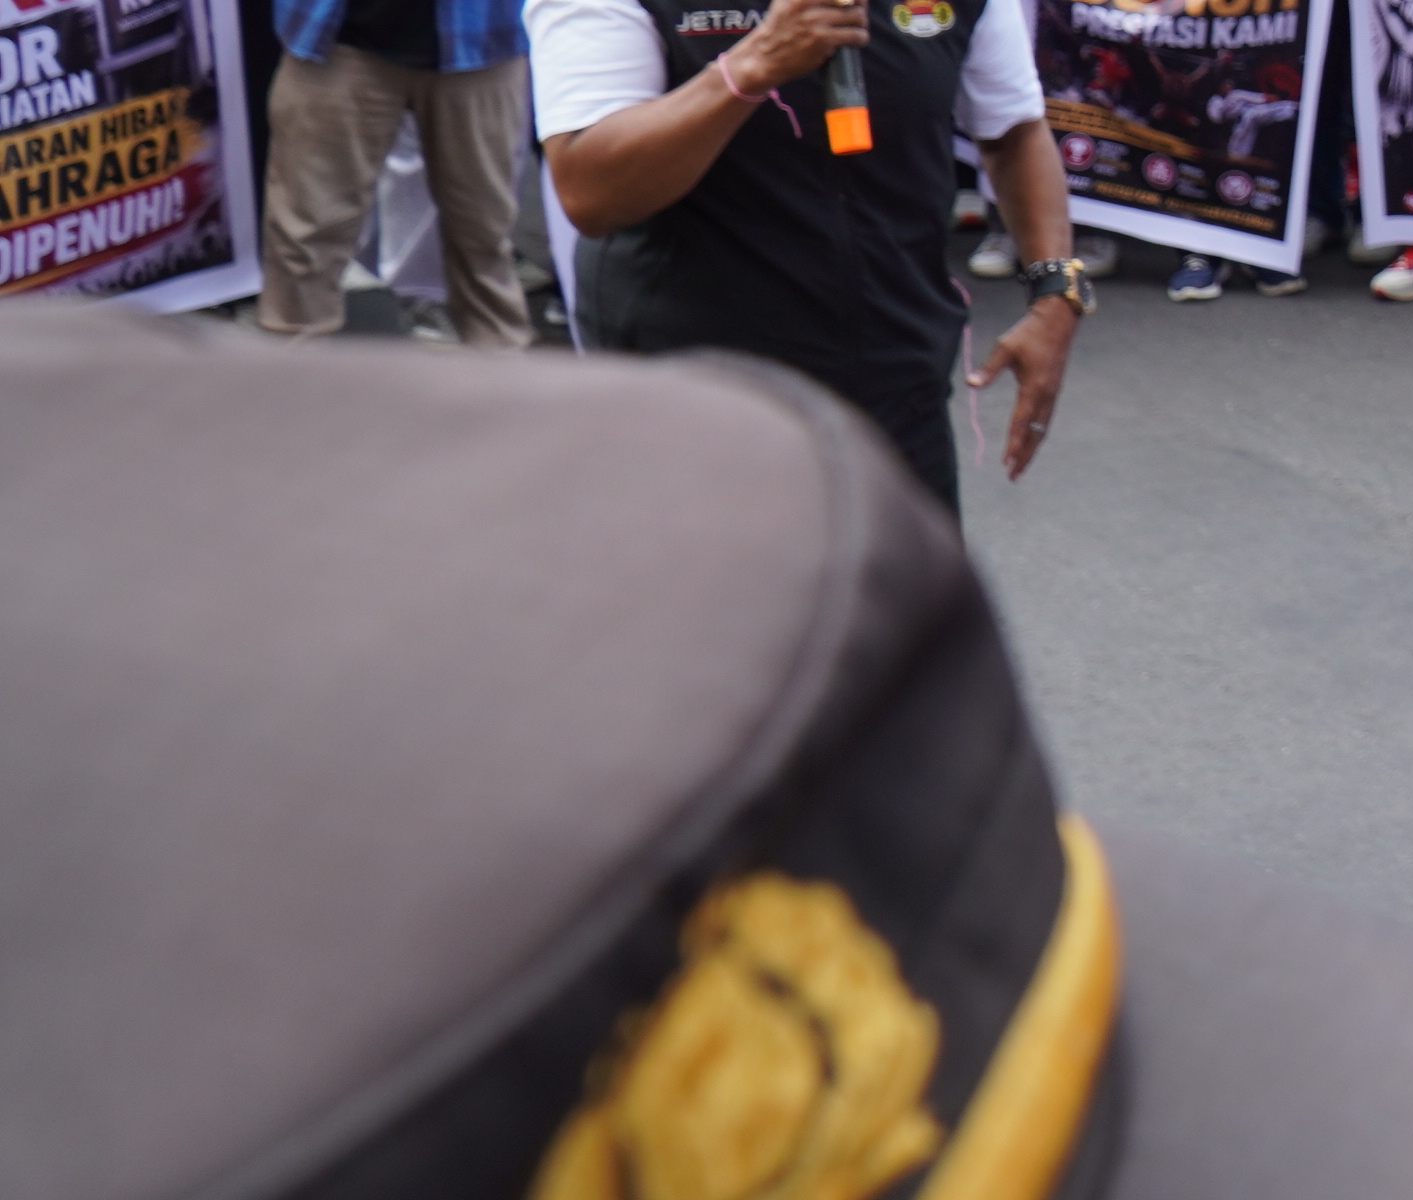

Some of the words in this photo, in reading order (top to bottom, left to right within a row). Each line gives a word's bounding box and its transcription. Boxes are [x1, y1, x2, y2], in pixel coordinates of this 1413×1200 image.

[675, 9, 769, 33] JETRA
[1210, 8, 1300, 49] KAMI
[0, 123, 91, 178] ARAN
